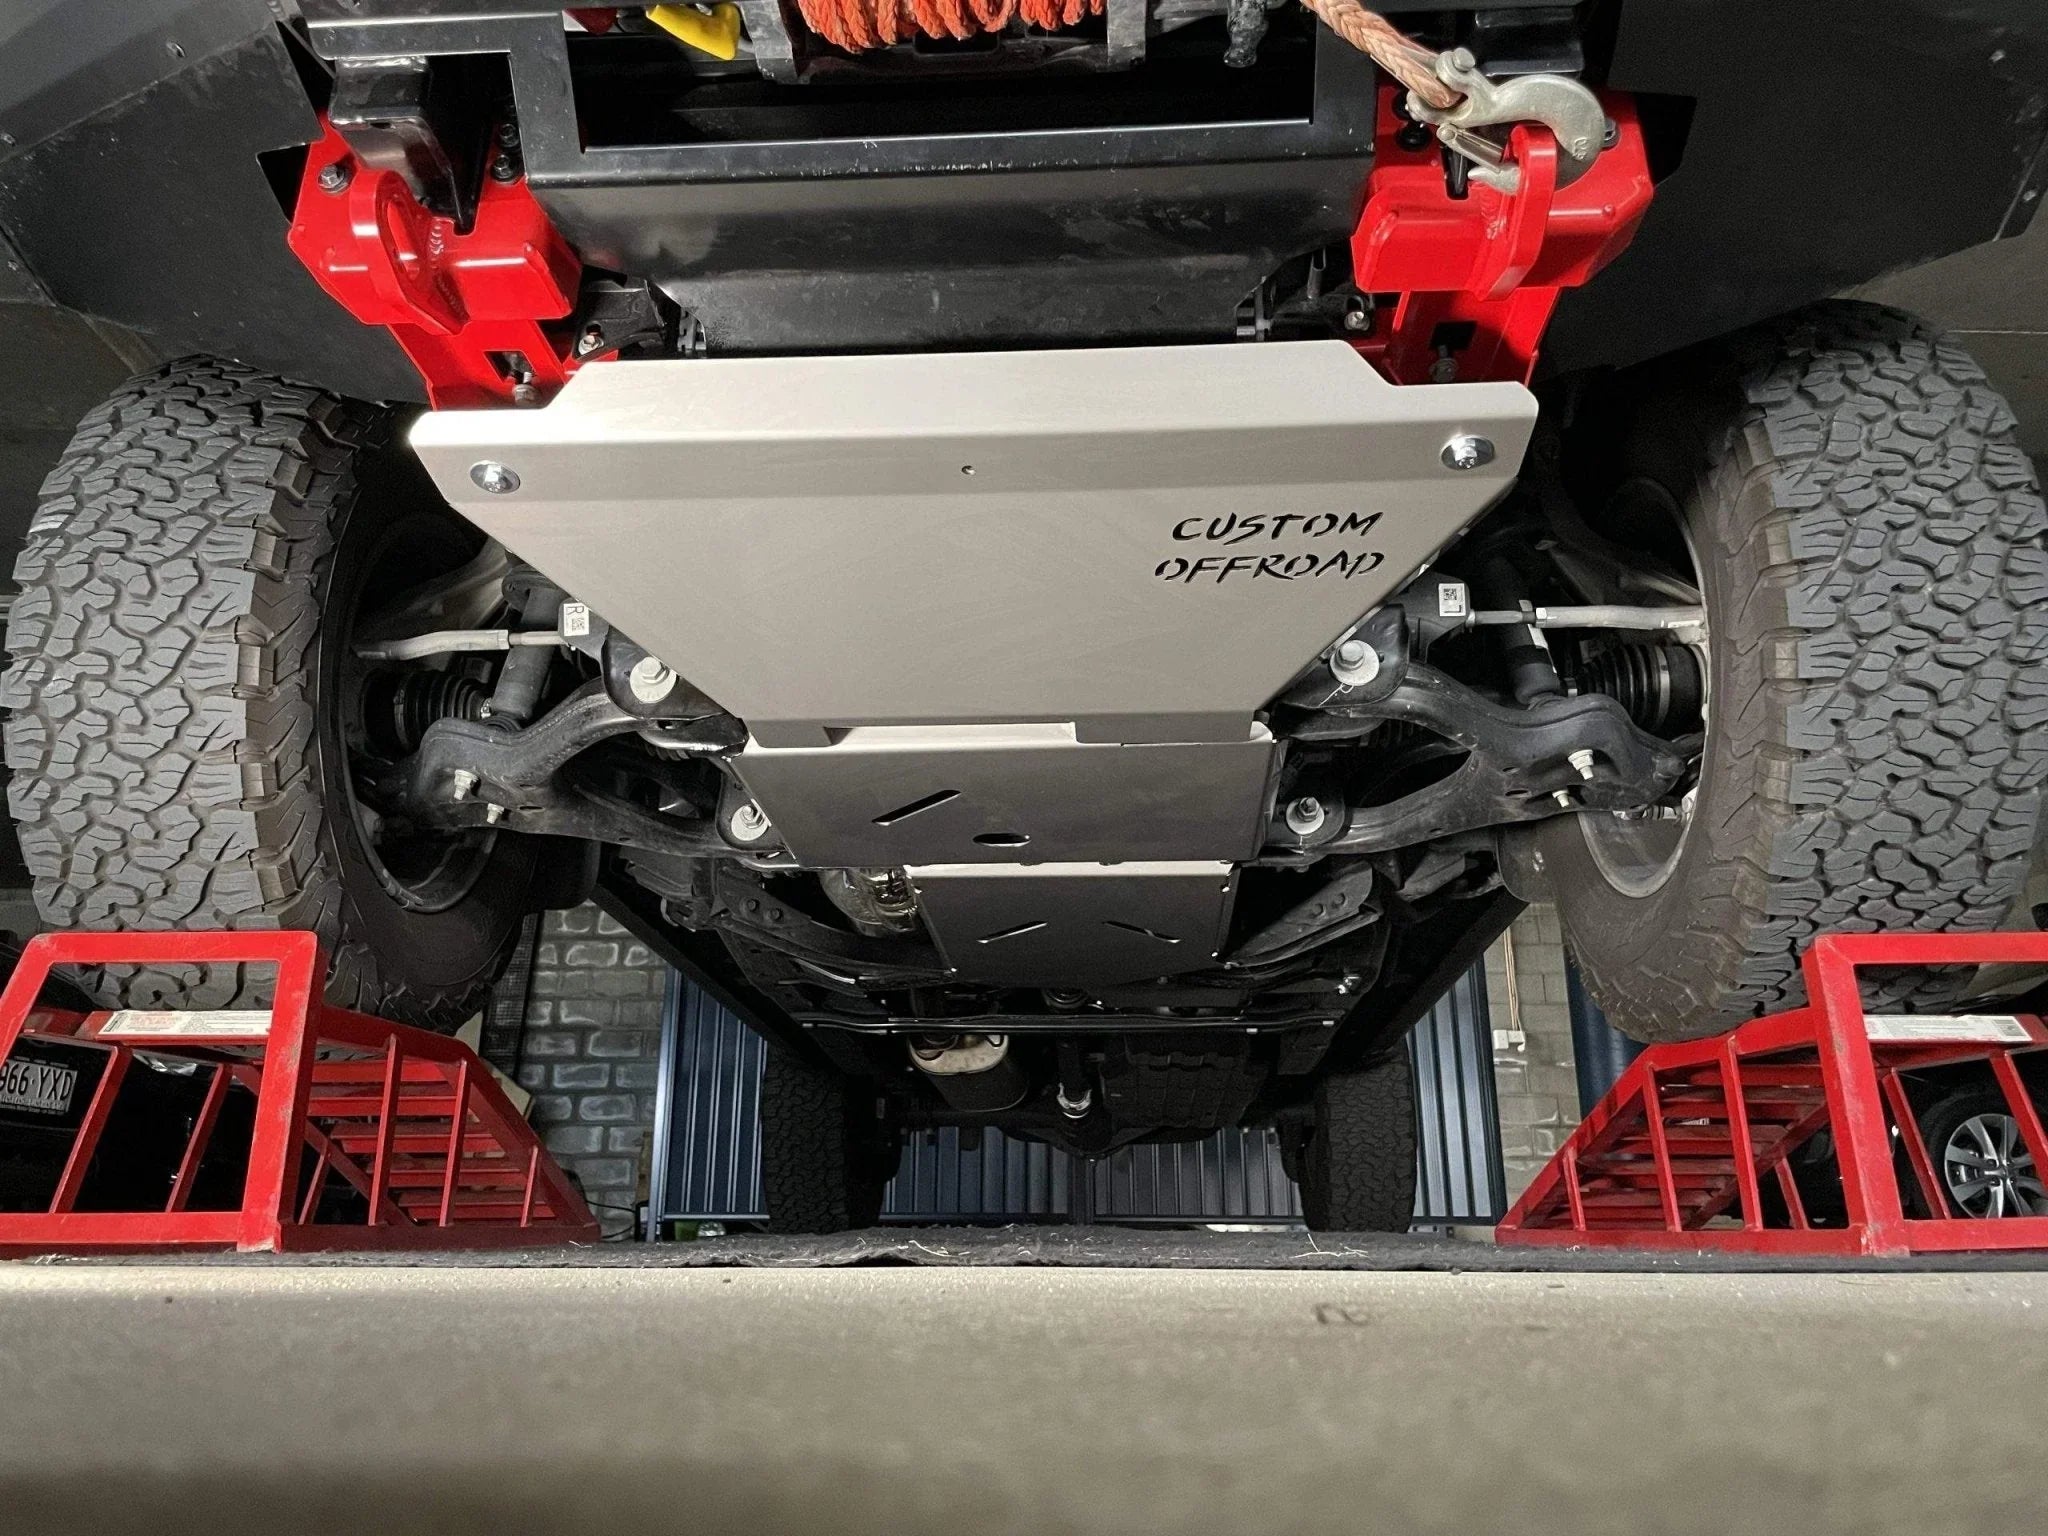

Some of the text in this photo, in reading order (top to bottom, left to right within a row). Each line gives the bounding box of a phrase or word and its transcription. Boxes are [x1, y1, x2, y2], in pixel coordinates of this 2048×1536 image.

[1172, 512, 1384, 546] CUSTOM
[1154, 549, 1385, 584] OFFROAD
[566, 605, 585, 616] R
[1444, 604, 1462, 614] L
